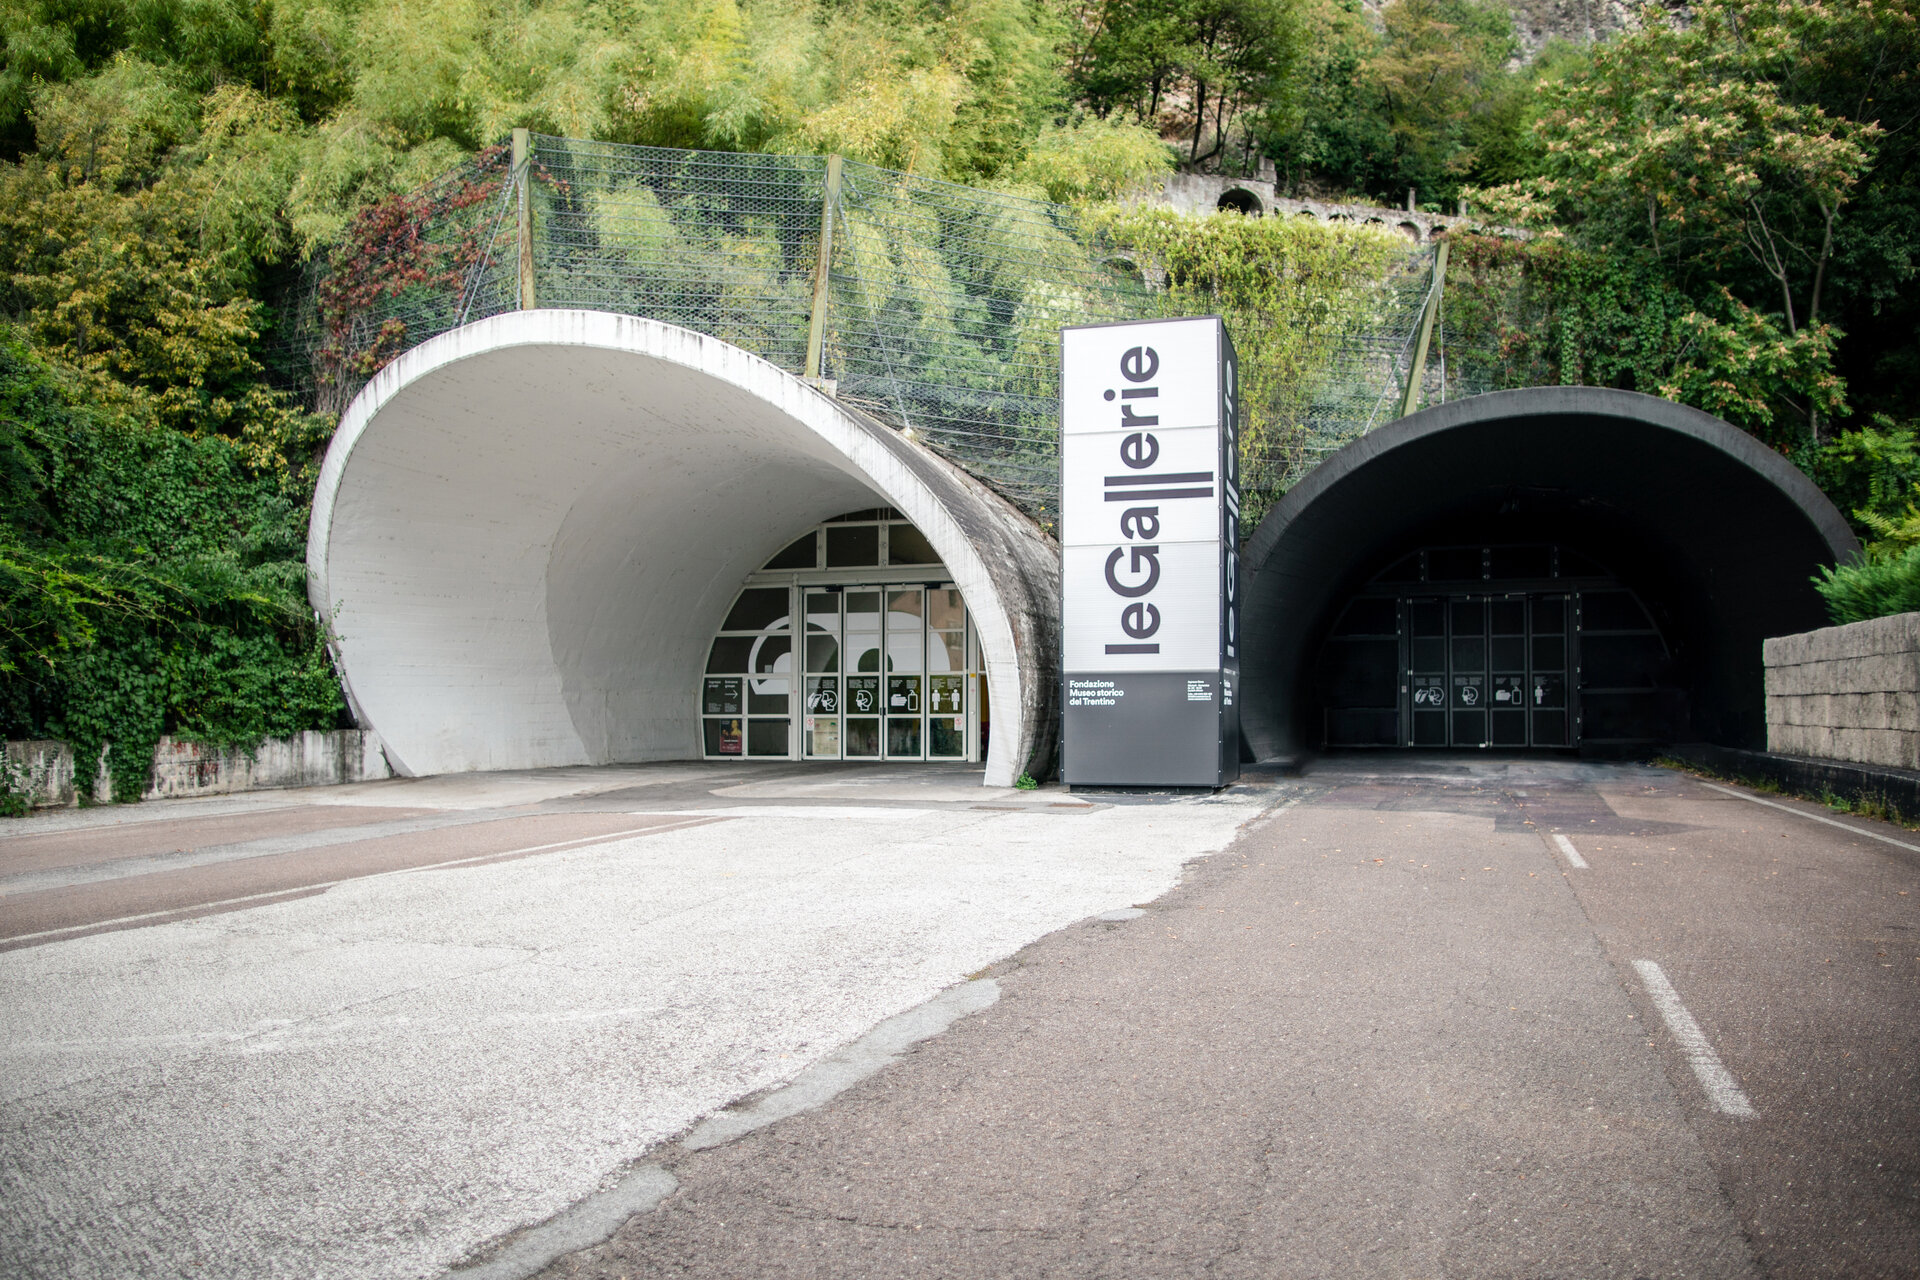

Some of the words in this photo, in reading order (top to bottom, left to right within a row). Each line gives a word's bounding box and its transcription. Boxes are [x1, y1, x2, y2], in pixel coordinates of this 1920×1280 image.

[1103, 346, 1214, 655] leGallerie
[1069, 680, 1115, 688] Fondazione
[1069, 689, 1096, 697] Museo
[1096, 688, 1125, 697] storico
[1069, 697, 1082, 706] del
[1082, 697, 1116, 706] Trentino
